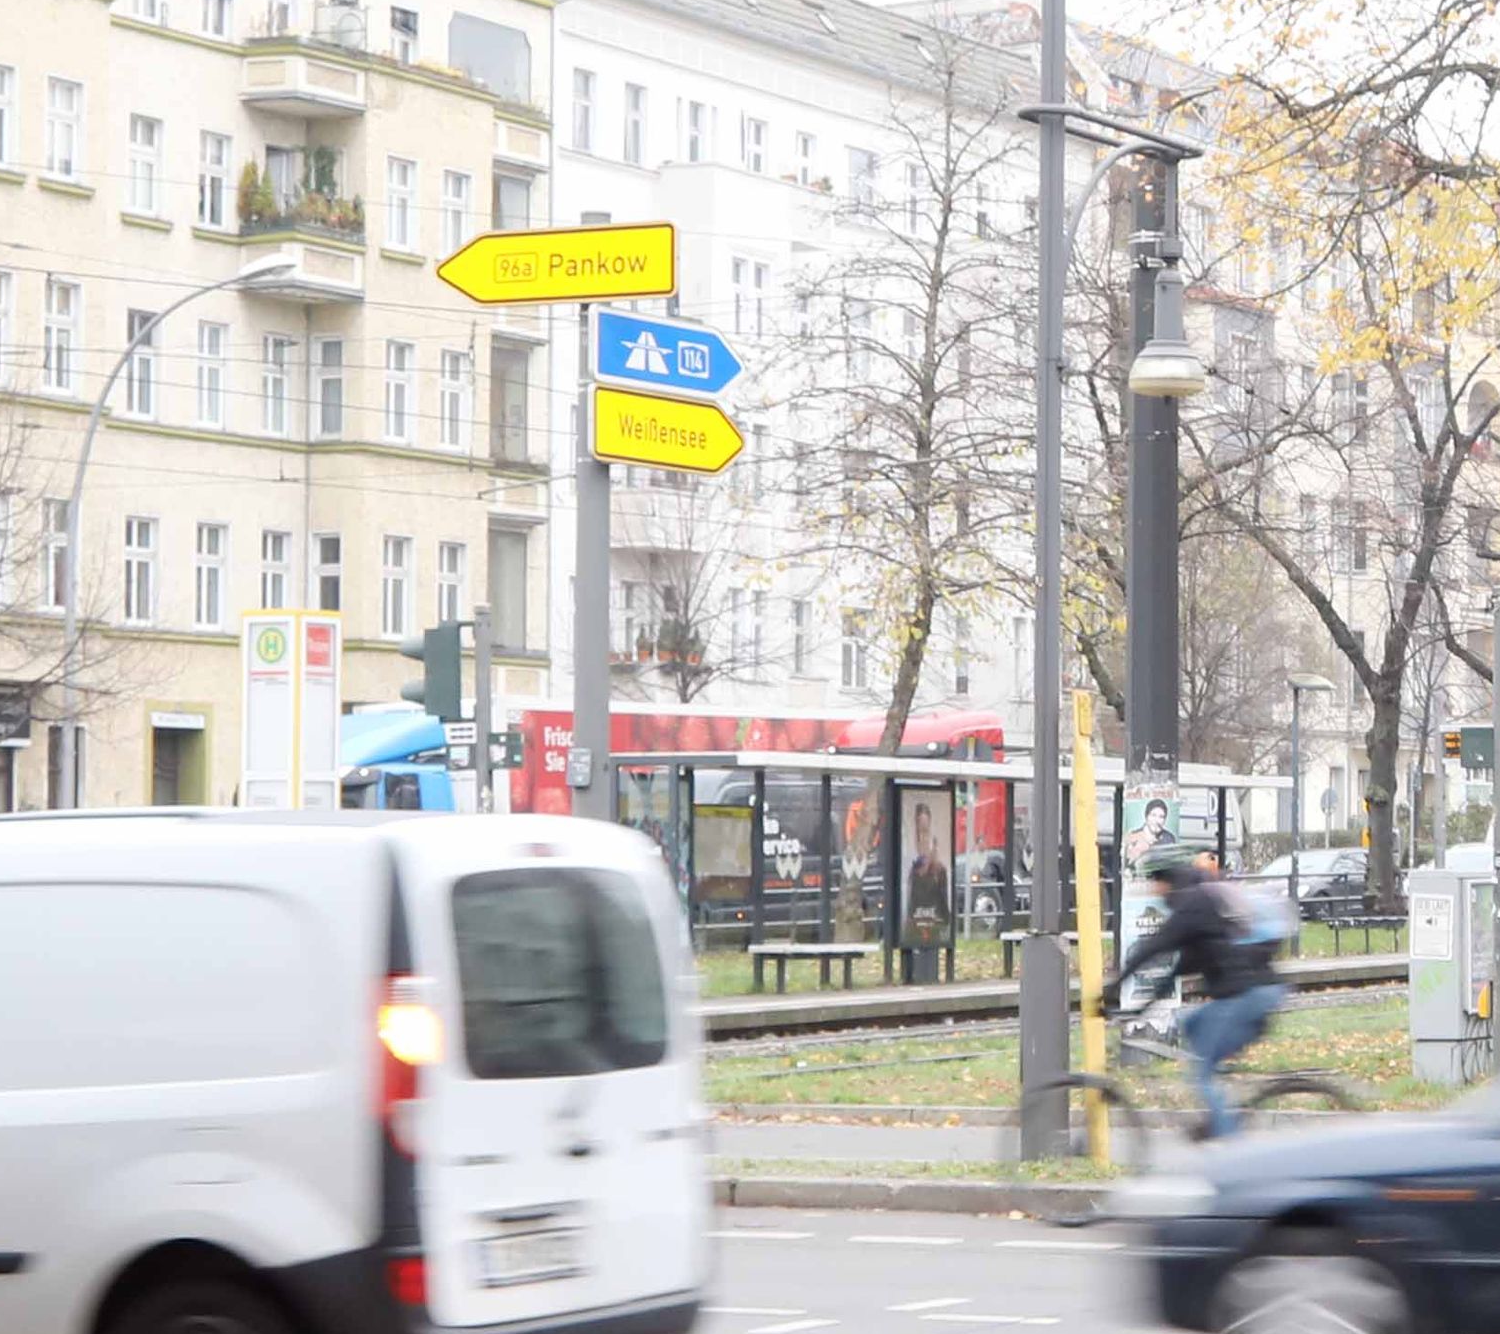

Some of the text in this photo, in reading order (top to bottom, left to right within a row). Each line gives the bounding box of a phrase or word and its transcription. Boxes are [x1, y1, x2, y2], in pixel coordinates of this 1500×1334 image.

[499, 252, 648, 278] 96a Pankow
[682, 348, 705, 371] 114
[618, 412, 708, 450] Weißensee
[545, 751, 566, 773] Sie
